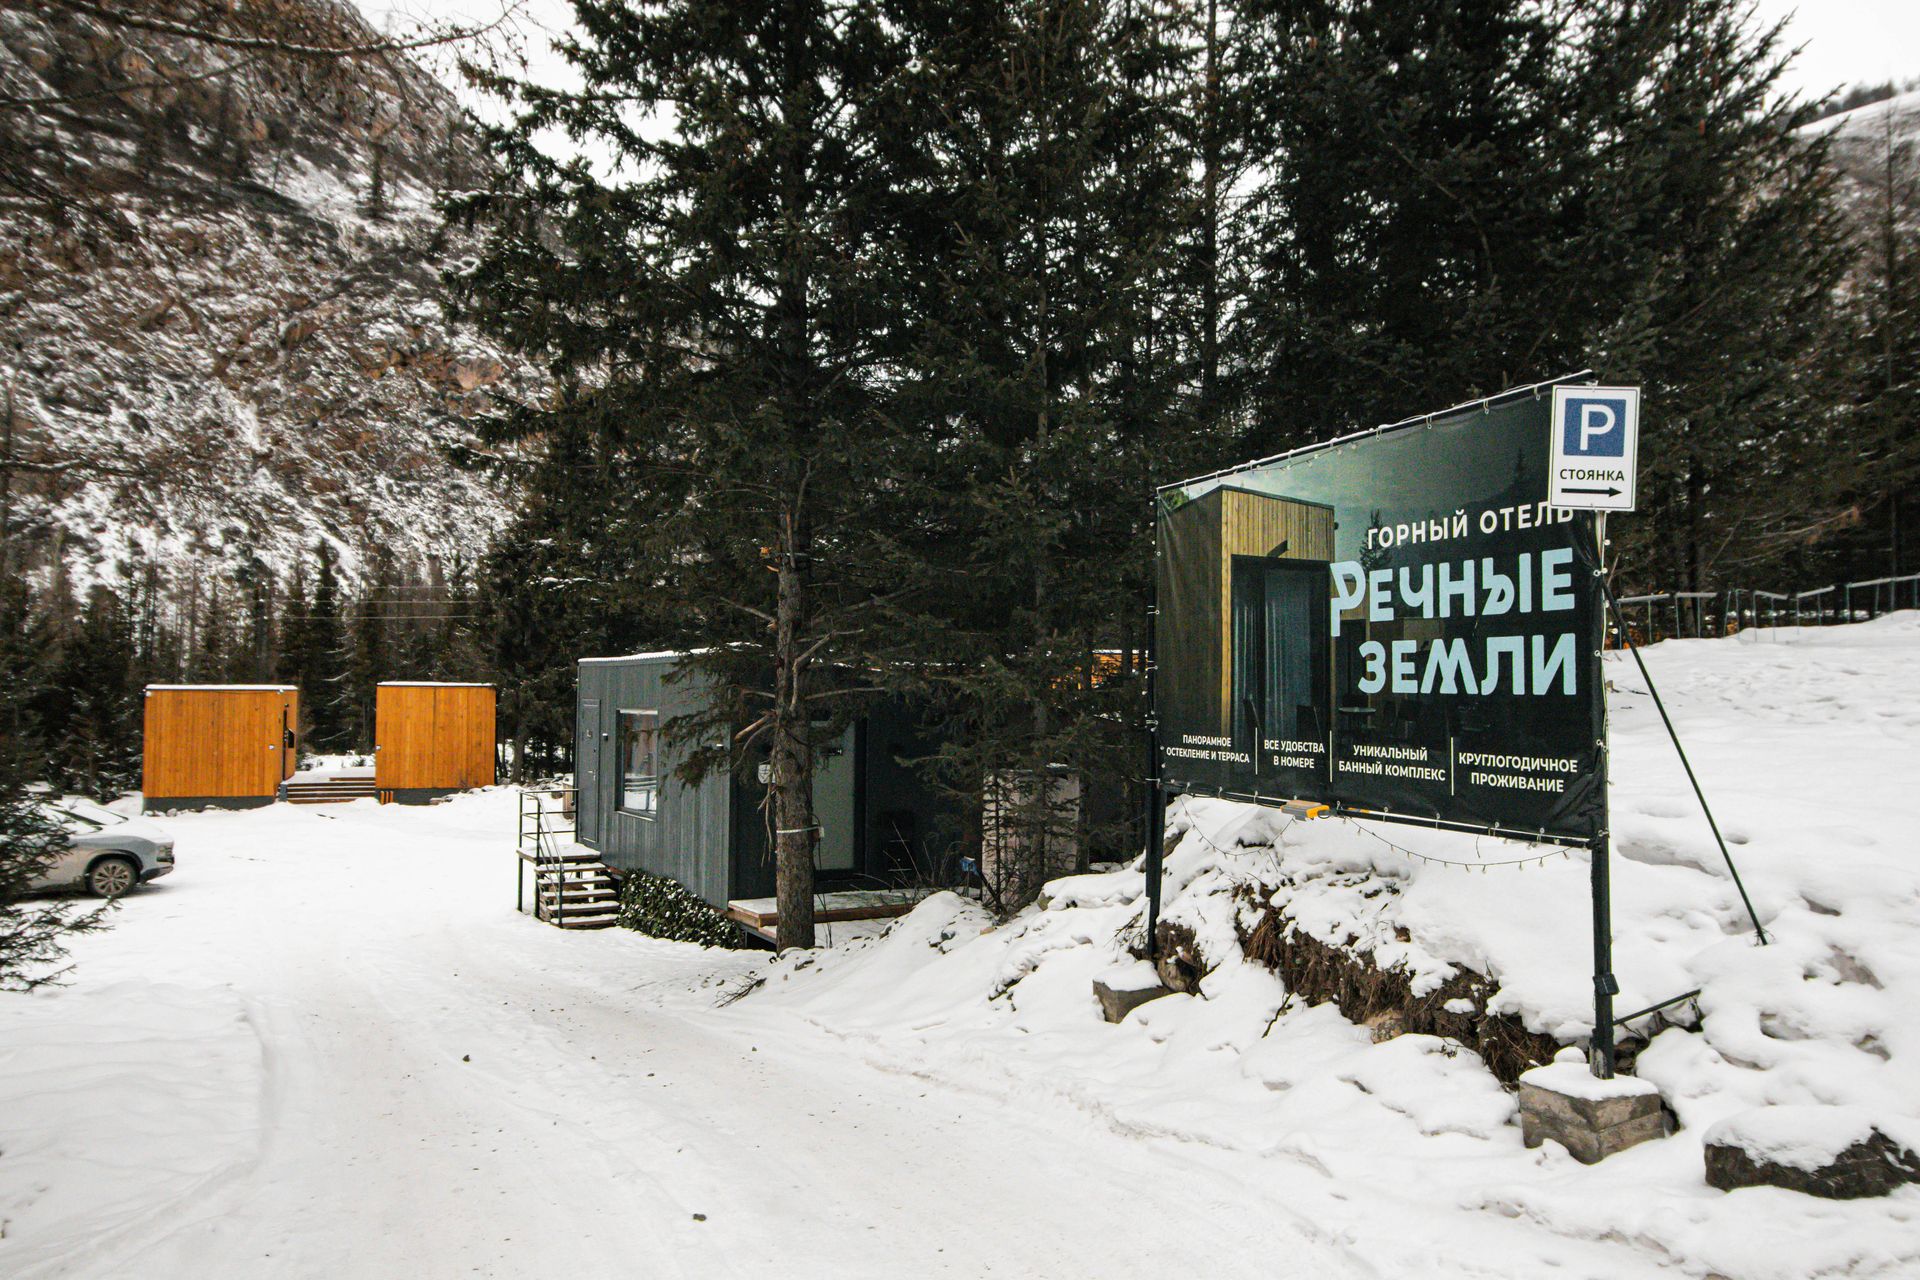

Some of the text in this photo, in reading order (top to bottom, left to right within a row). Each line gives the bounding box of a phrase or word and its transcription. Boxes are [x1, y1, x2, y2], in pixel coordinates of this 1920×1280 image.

[1580, 404, 1615, 450] P
[1560, 469, 1624, 481] СТОЯНКА
[1367, 509, 1467, 549] ГОРНЫЙ
[1330, 548, 1575, 637] РЕЧНЫЕ
[1358, 633, 1577, 696] ЗЕМЛИ
[1182, 734, 1231, 747] ПАНОРАМНОЕ
[1264, 739, 1325, 754] ВСЕ УДОБСТВА
[1166, 748, 1250, 764] ОСТЕКЛЕНИЕ И ТЕРРАСА
[1273, 755, 1315, 769] В НОМЕРЕ
[1353, 744, 1428, 761] УНИКАЛЬНЫЙ
[1458, 752, 1578, 773] КРУГЛОГОДИЧНОЕ
[1338, 760, 1446, 782] БАННЫЙ КОМПЛЕКС
[1471, 771, 1564, 793] ПРОЖИВАНИЕ
